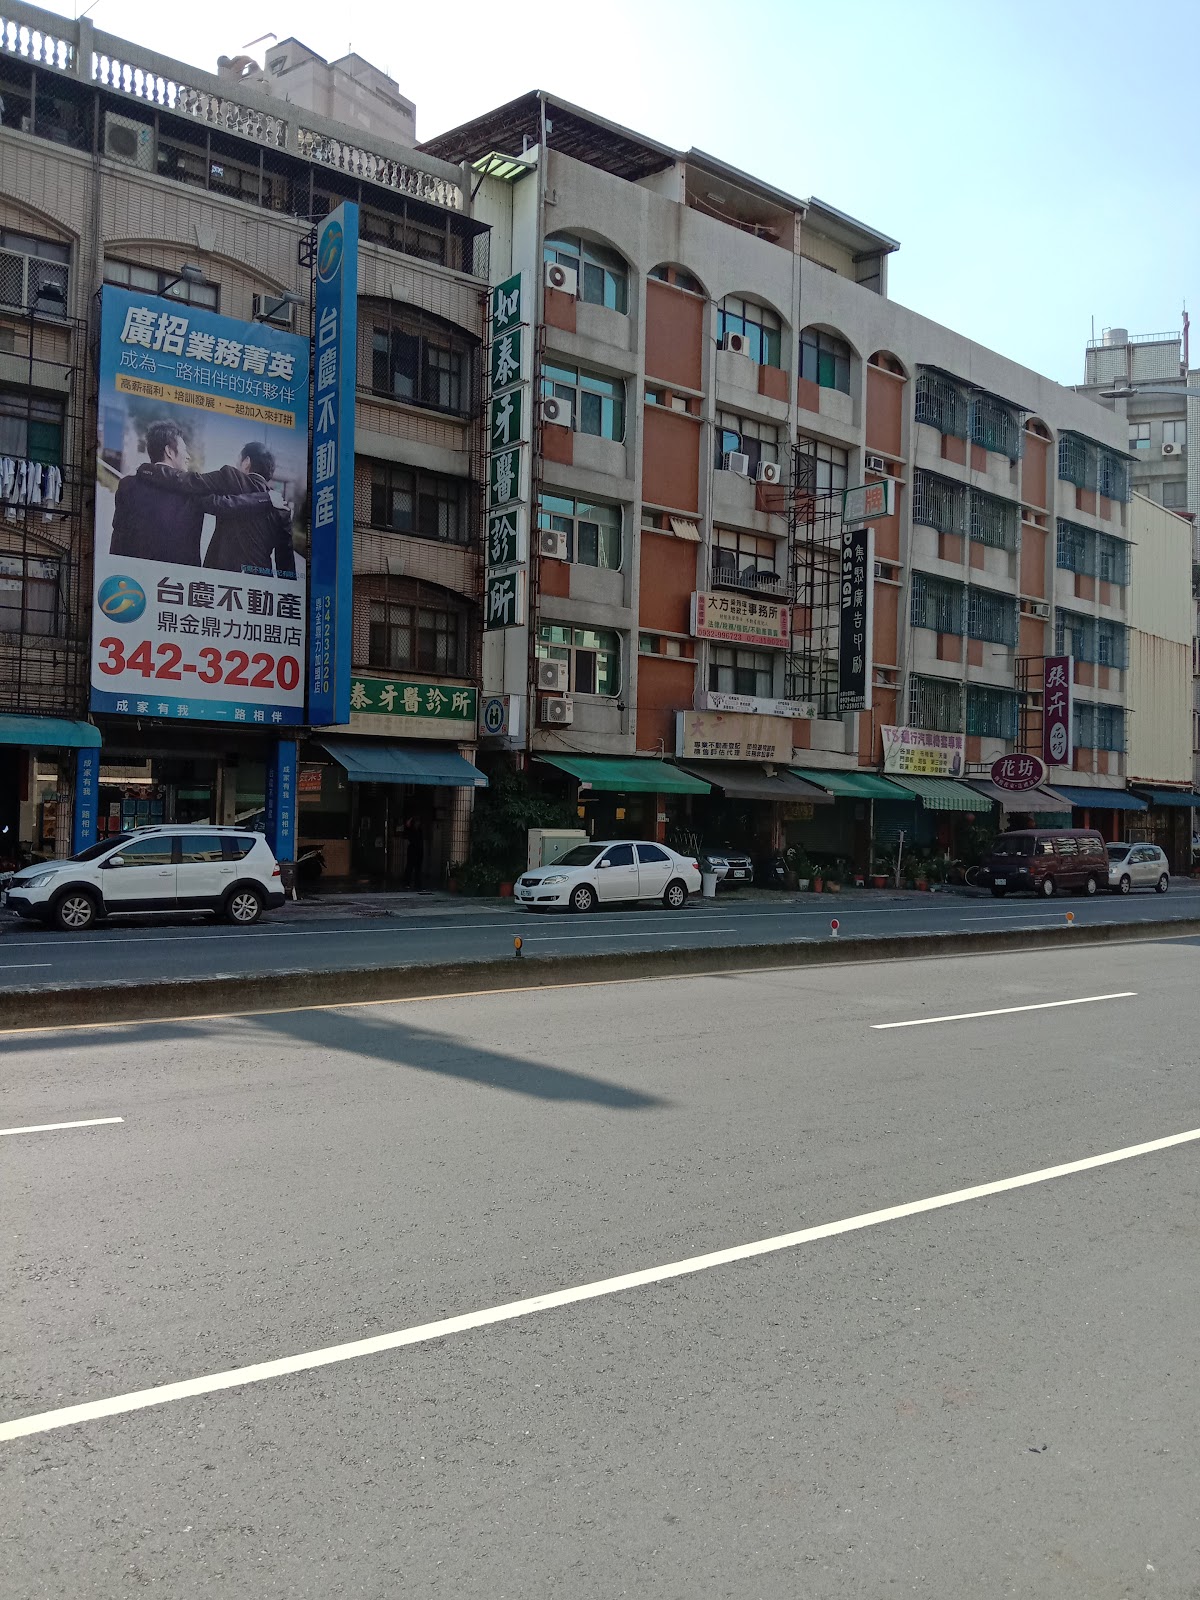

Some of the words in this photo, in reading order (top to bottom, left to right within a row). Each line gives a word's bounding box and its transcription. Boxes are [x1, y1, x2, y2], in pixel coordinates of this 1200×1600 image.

[120, 307, 296, 381] 廣招業務菁英
[119, 349, 296, 404] 成為一路相伴的好夥伴
[315, 306, 337, 529] 台慶不動產
[489, 288, 520, 625] 如泰牙醫診所
[157, 577, 302, 620] 台慶不動產
[708, 596, 729, 612] 大方
[748, 602, 778, 619] 事務所
[157, 612, 303, 647] 鼎金鼎力加盟店
[97, 636, 300, 691] 342-3220
[350, 681, 472, 717] 泰牙醫診所
[1052, 727, 1064, 754] 花坊
[1001, 759, 1034, 777] 花坊
